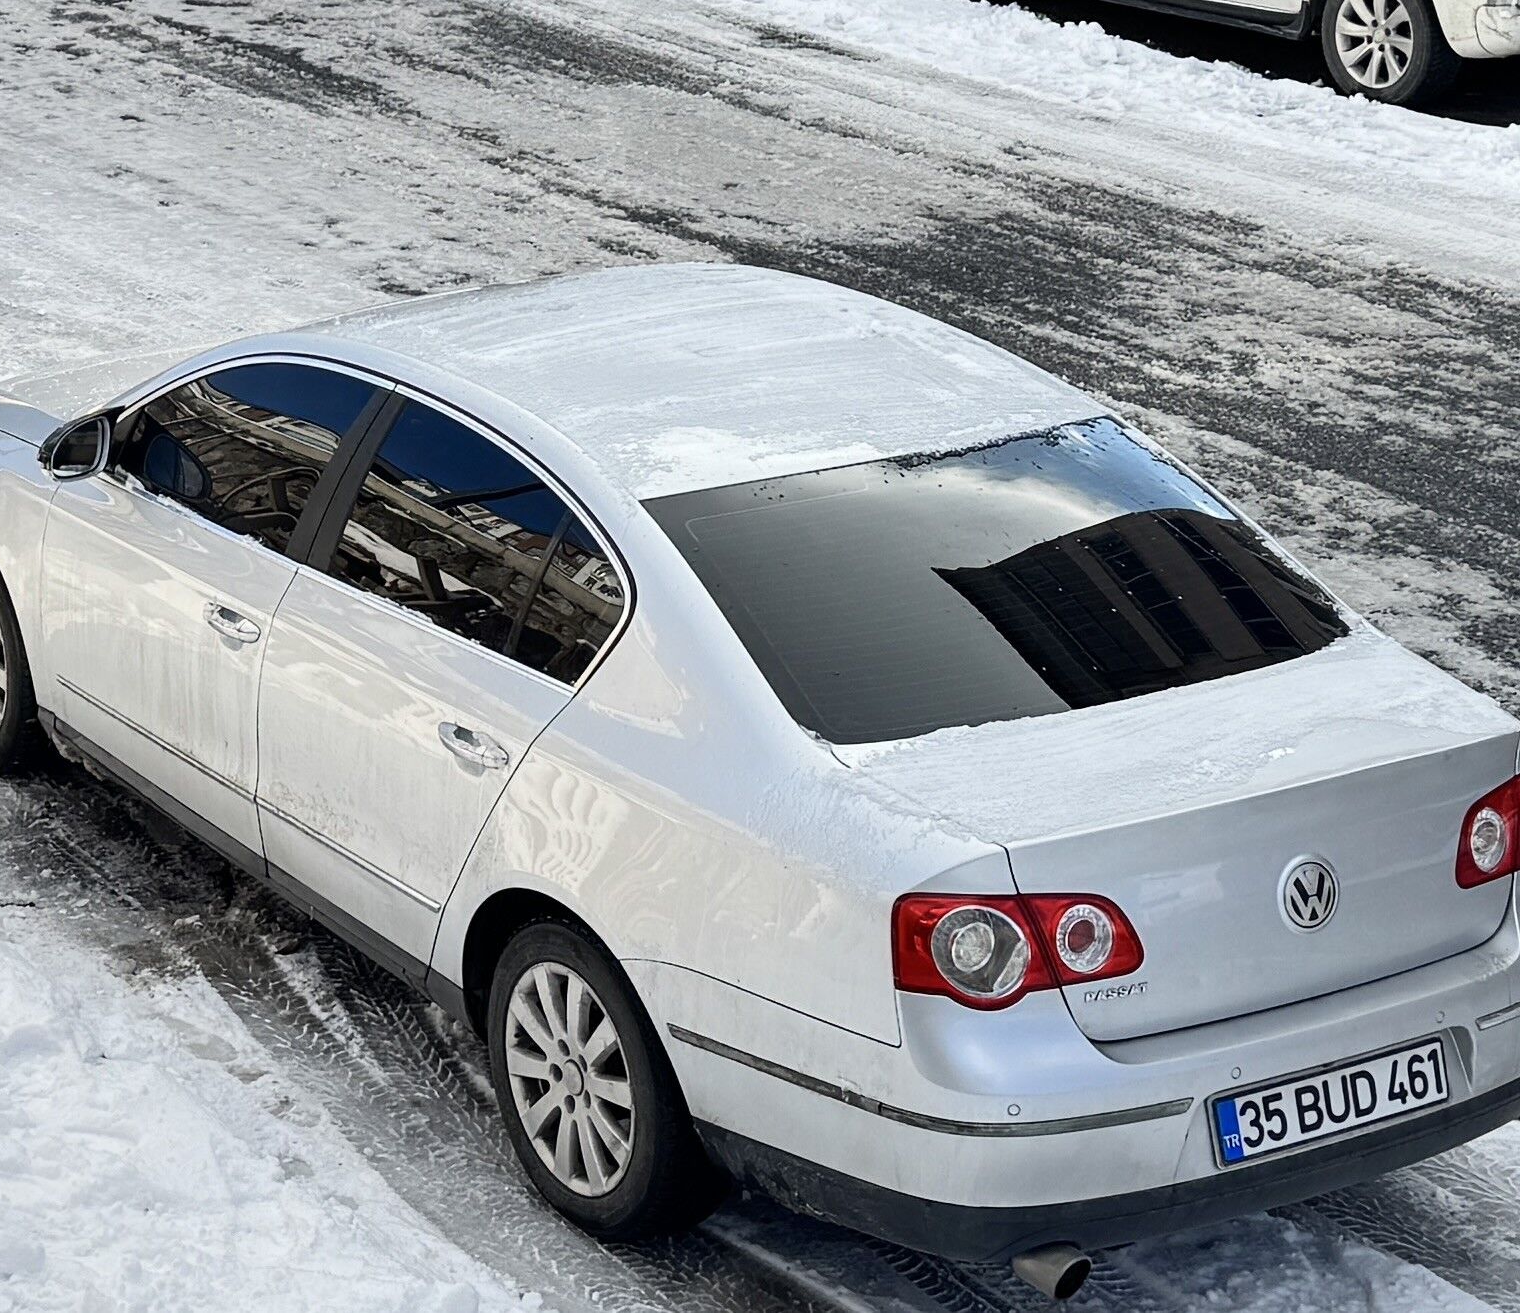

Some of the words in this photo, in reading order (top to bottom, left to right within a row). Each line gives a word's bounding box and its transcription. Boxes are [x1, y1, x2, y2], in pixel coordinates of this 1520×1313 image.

[1084, 981, 1148, 1003] PASSAT
[1223, 1133, 1241, 1150] TR
[1239, 1092, 1288, 1149] 35
[1294, 1069, 1378, 1134] BUD
[1388, 1048, 1444, 1105] 461
